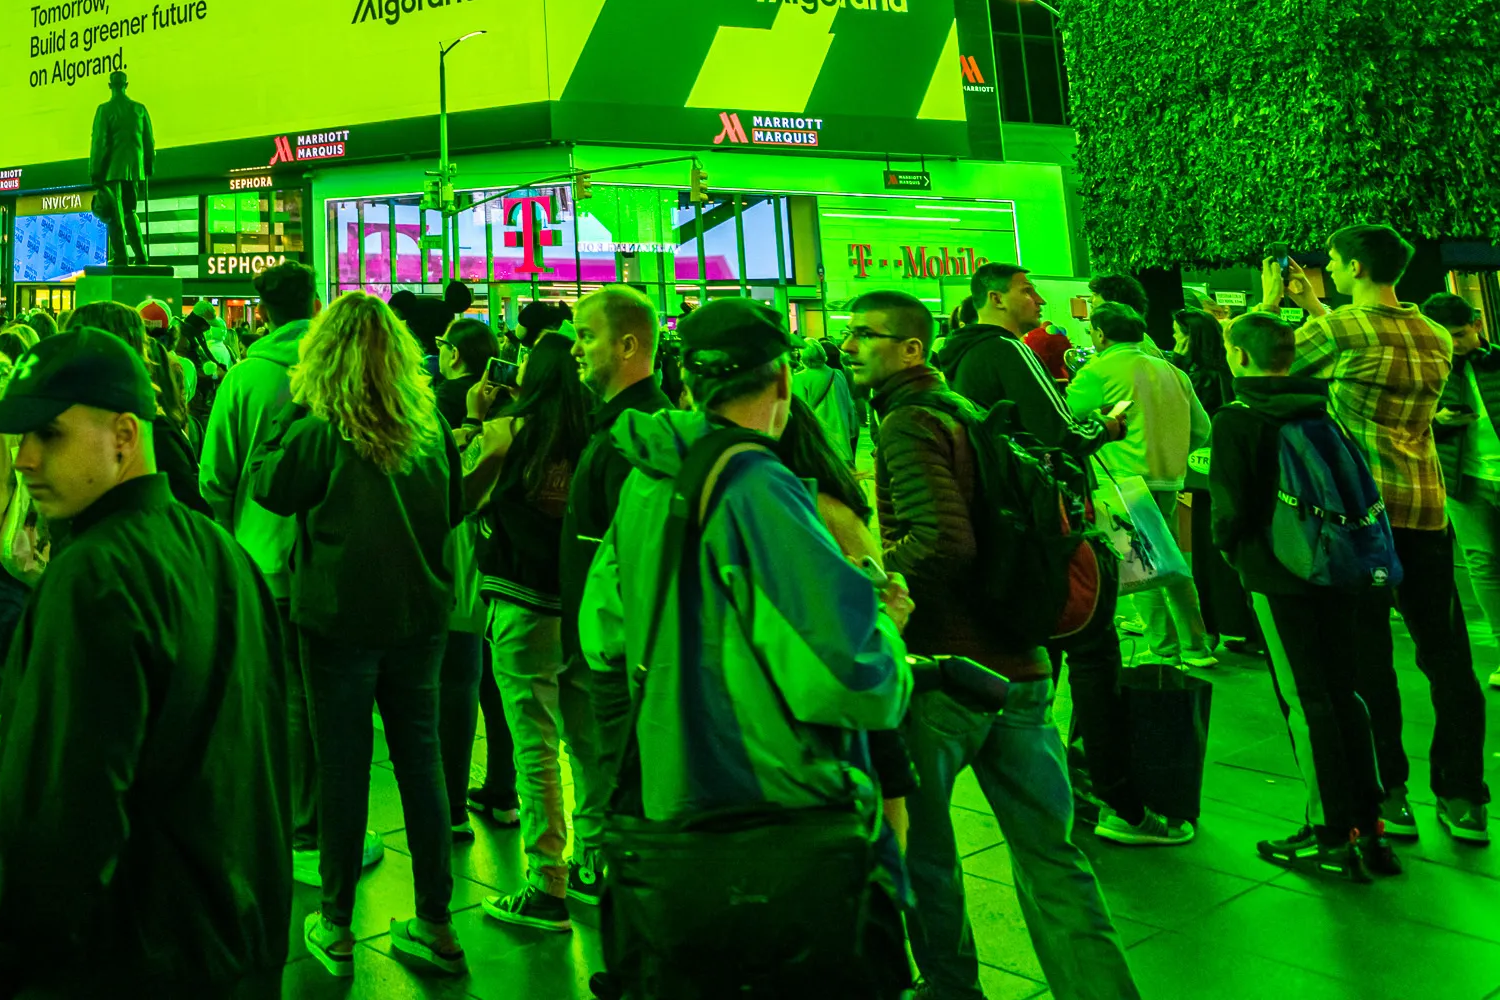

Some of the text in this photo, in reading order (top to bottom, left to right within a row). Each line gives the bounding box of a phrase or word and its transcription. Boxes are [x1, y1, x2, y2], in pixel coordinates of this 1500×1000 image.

[30, 0, 208, 58] Build a greener future
[29, 47, 128, 88] on Algorand.
[752, 115, 823, 131] MARRIOTT
[296, 130, 351, 146] MARRIOTT
[753, 130, 817, 145] MARQUIS
[297, 144, 344, 159] MARQUIS
[229, 176, 273, 190] SEPHORA
[897, 174, 923, 182] MARRIOTT
[41, 193, 82, 211] INVICTA
